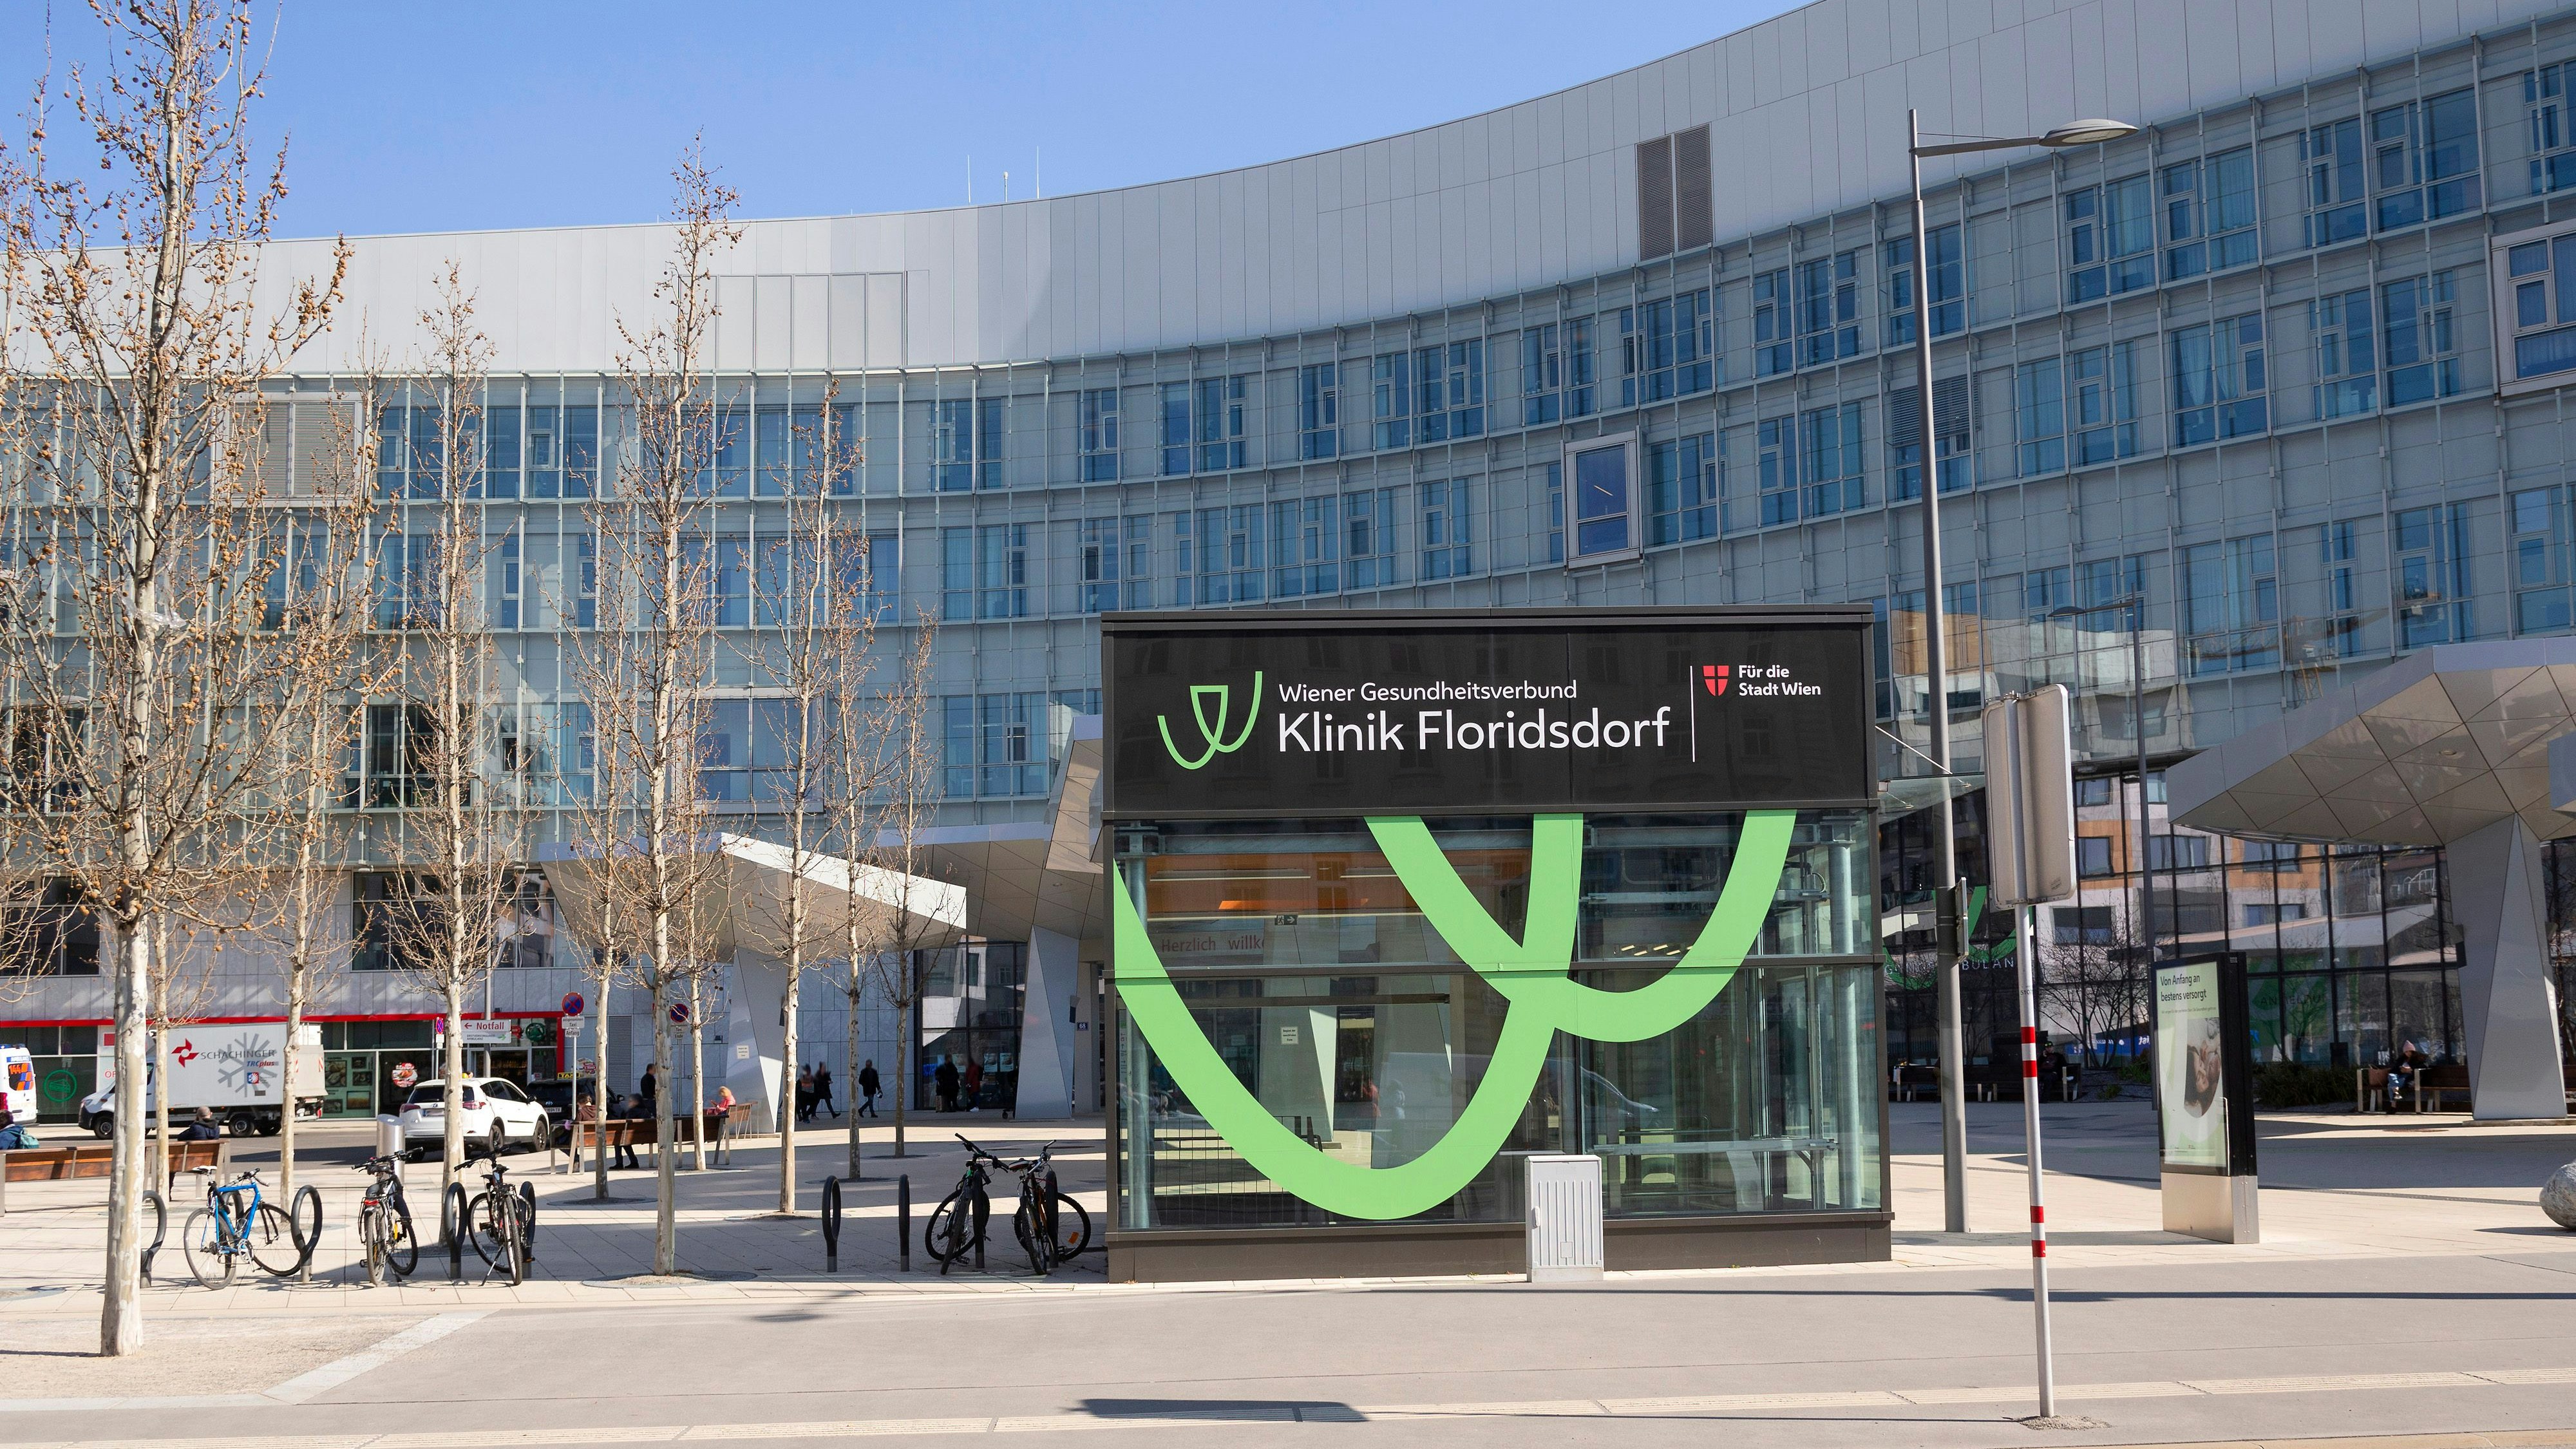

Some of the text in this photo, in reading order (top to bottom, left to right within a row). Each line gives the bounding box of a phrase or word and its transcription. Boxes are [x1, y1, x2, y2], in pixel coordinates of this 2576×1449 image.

[1739, 665, 1790, 678] Für die
[1278, 679, 1577, 702] Wiener Gesundheitsverbund
[1739, 683, 1821, 696] Stadt Wien
[1279, 706, 1671, 752] Klinik Floridsdorf
[1161, 935, 1264, 952] Herzlich willk
[1962, 957, 2014, 971] BULAN
[2161, 976, 2171, 986] Von
[2172, 974, 2192, 986] Anfang
[2161, 989, 2206, 1001] bestens versorgt
[477, 1021, 504, 1030] Notfall
[200, 1050, 276, 1060] SCHACHINGER
[9, 1064, 21, 1075] 144
